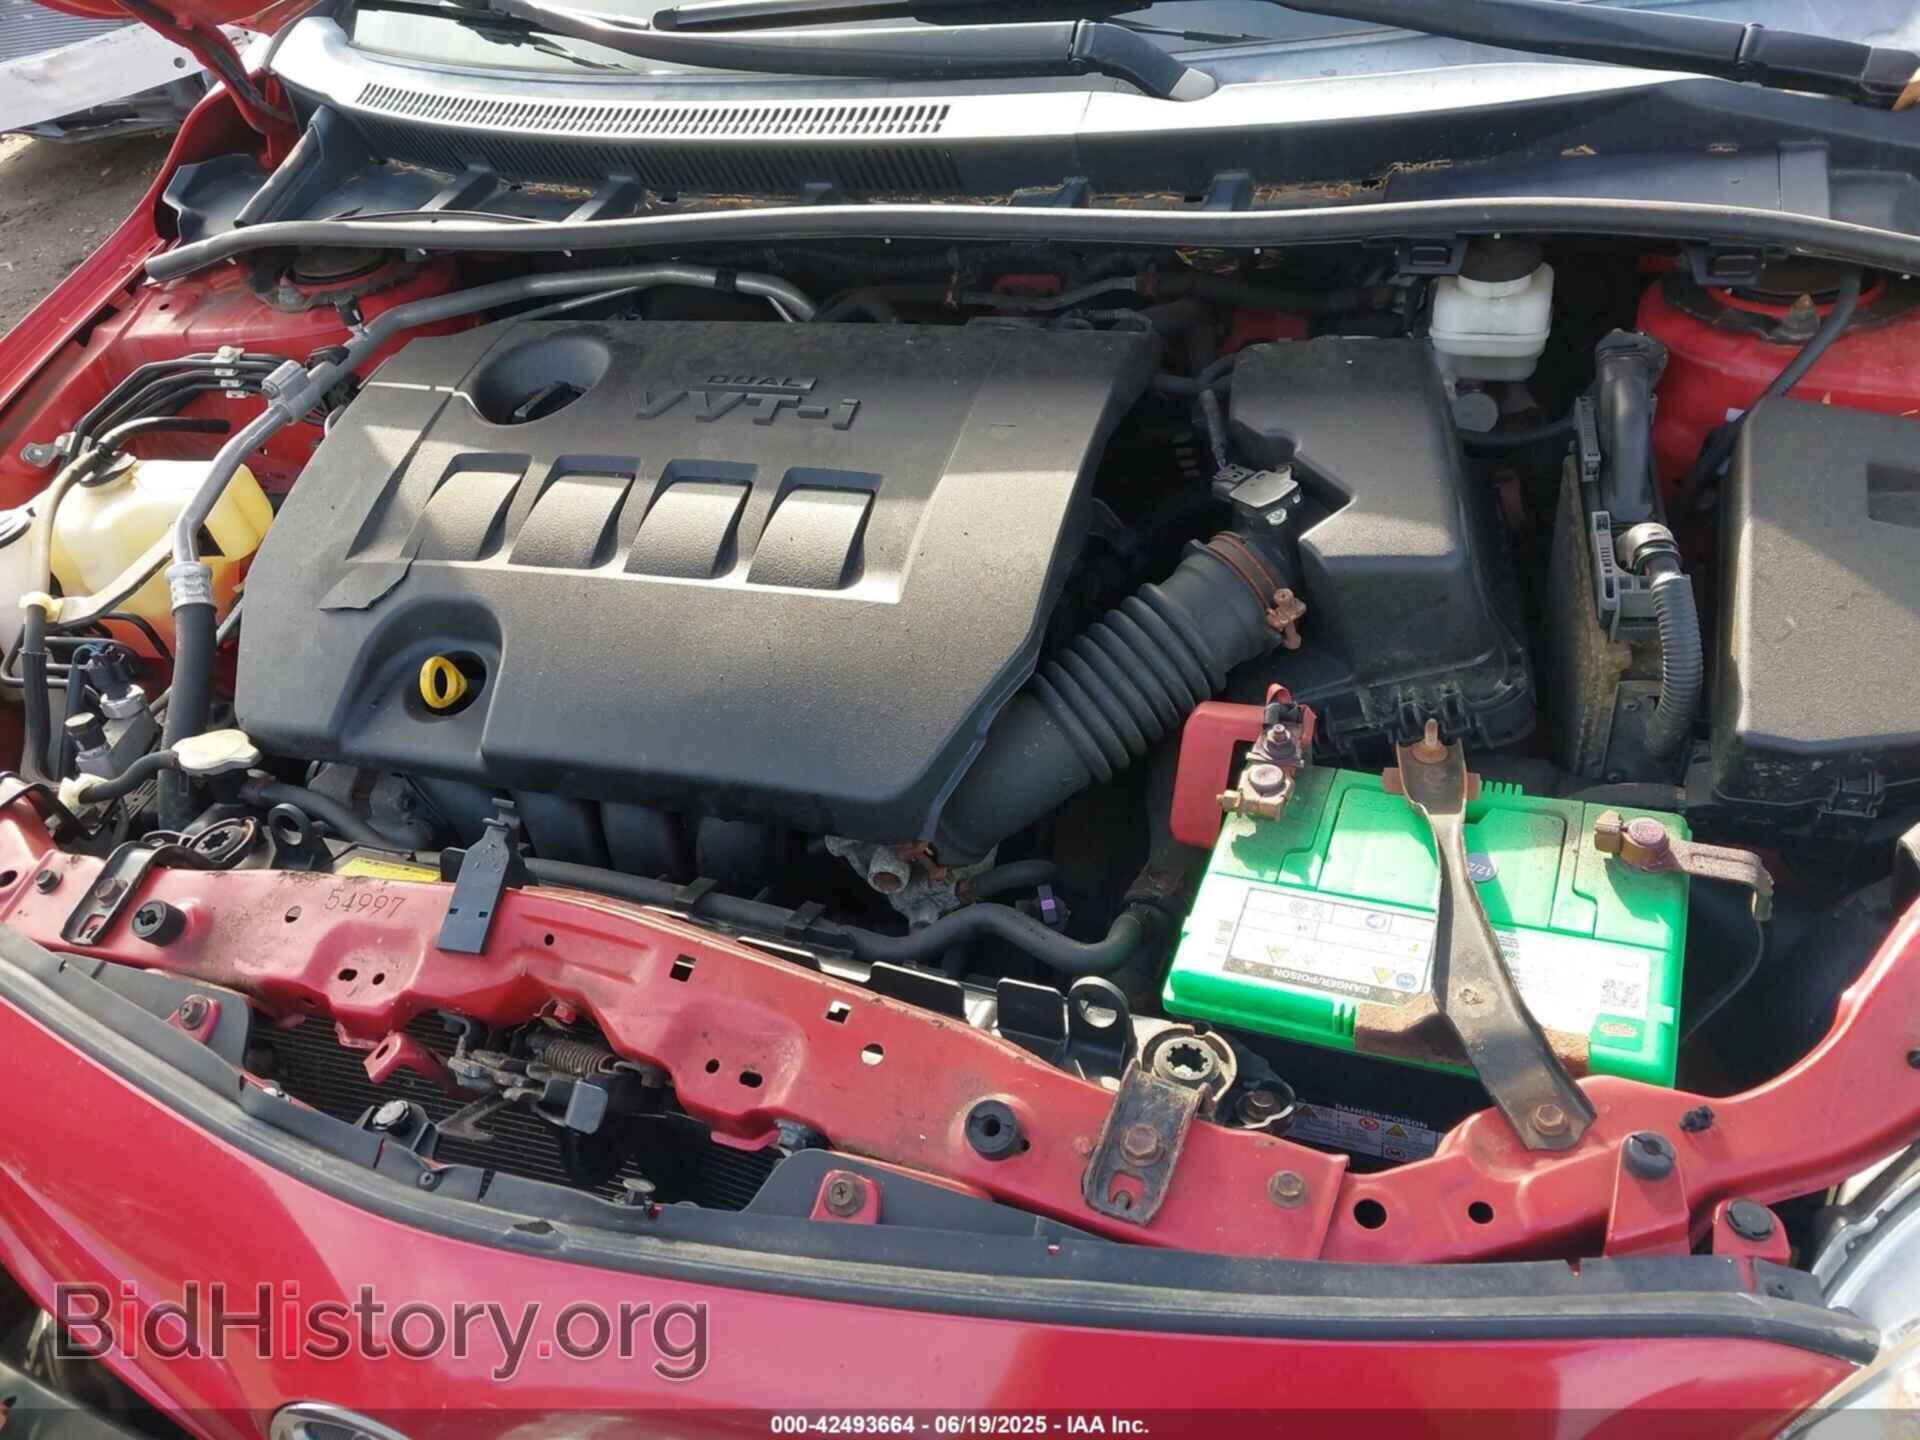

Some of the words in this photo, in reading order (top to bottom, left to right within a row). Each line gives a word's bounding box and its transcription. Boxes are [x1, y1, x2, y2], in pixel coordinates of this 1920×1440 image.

[706, 374, 803, 387] DUAL
[325, 887, 406, 919] 54997
[1272, 966, 1371, 995] DANGER/POISON
[1335, 1103, 1429, 1129] DANGER/POISON
